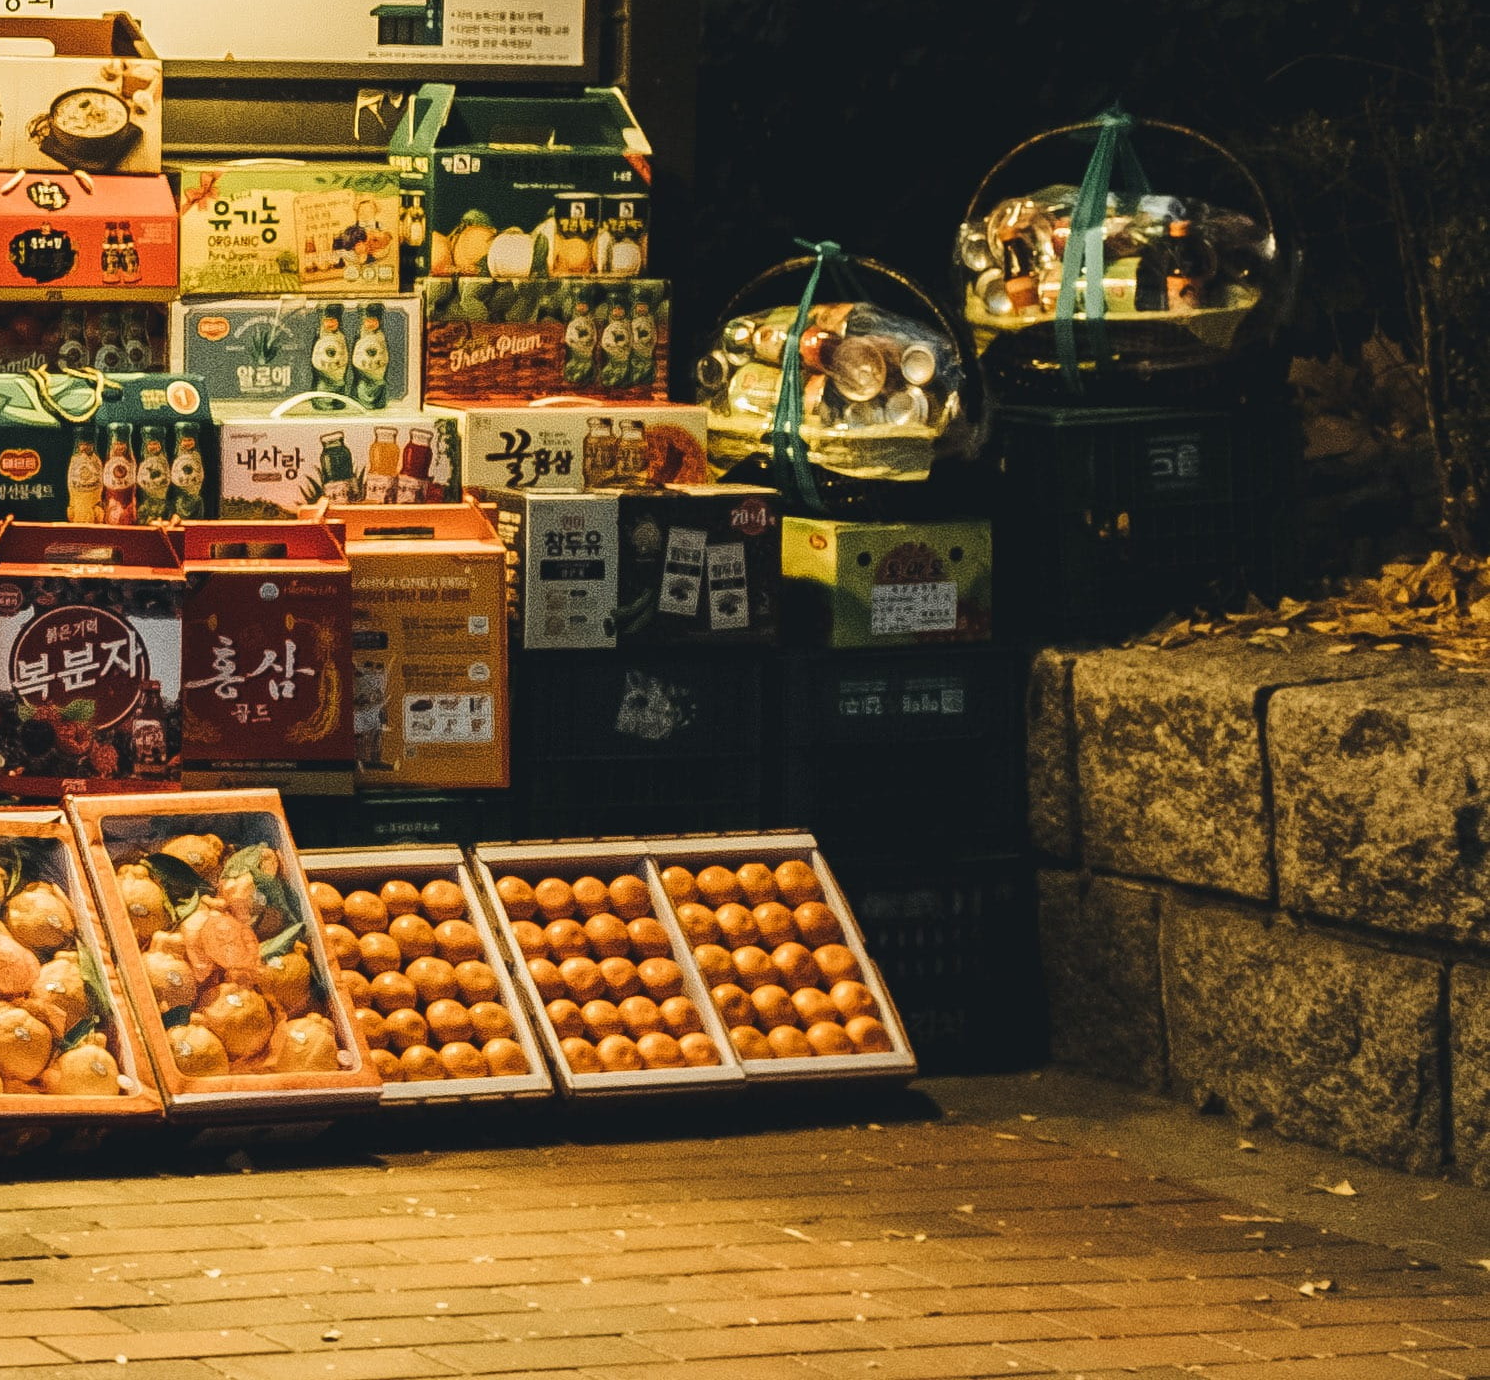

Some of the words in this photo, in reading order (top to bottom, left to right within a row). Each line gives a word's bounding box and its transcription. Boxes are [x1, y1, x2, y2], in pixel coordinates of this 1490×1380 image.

[208, 196, 281, 245] 유기농
[207, 235, 259, 248] ORGANIC
[449, 345, 497, 373] Fresh
[236, 364, 292, 389] 알로에
[236, 445, 306, 481] 내사랑
[544, 530, 603, 557] 참두유
[13, 631, 144, 701] 복분자
[184, 634, 316, 700] 홍삼
[230, 703, 273, 724] 골드
